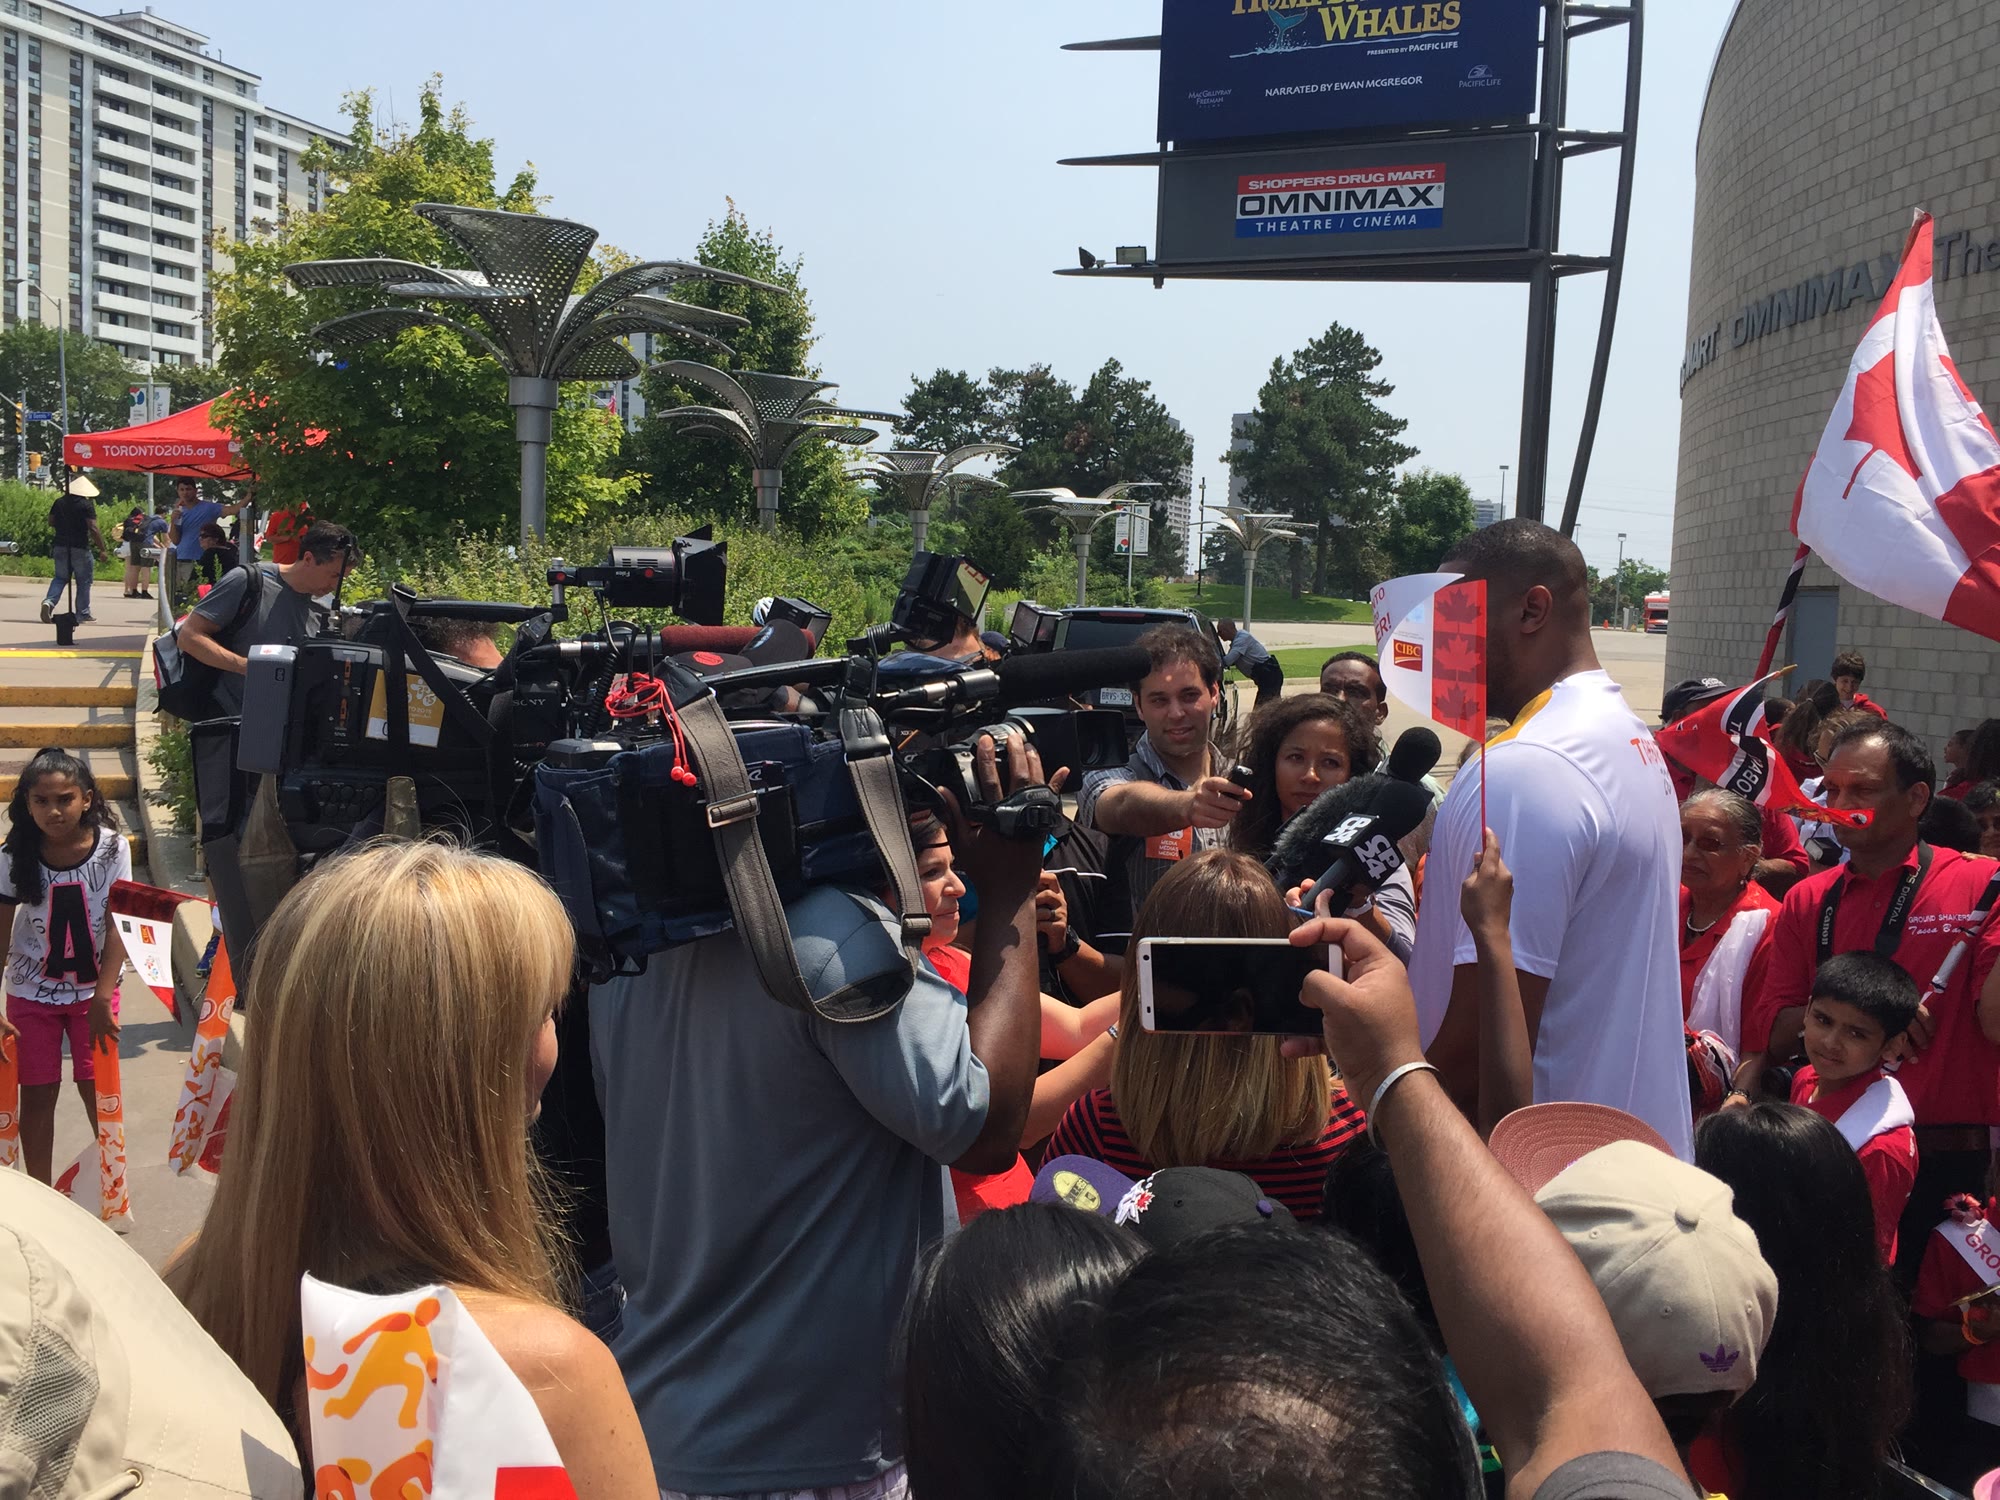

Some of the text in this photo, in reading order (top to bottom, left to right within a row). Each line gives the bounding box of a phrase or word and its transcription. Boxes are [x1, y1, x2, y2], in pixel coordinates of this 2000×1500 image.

[1318, 1, 1461, 41] WHALES
[1367, 48, 1399, 56] PRESENTED
[1409, 42, 1440, 52] PACIFIC
[1440, 41, 1459, 50] LIFE
[1265, 76, 1423, 97] NARRATED BY EWAN MCGREGOR
[1459, 78, 1501, 88] PACIFIC LIFE
[1248, 169, 1436, 190] SHOPPERS DRUG MART
[1239, 185, 1435, 217] OMNIMAX
[1256, 219, 1332, 233] THEATRE
[1353, 213, 1417, 228] CINÉMA
[102, 445, 216, 459] TORONTO2015.org
[1395, 642, 1422, 657] CIBC
[1888, 886, 1911, 925] DIGITAL
[1821, 905, 1833, 945] Canon
[1908, 913, 1971, 923] GROUND SHAKERS
